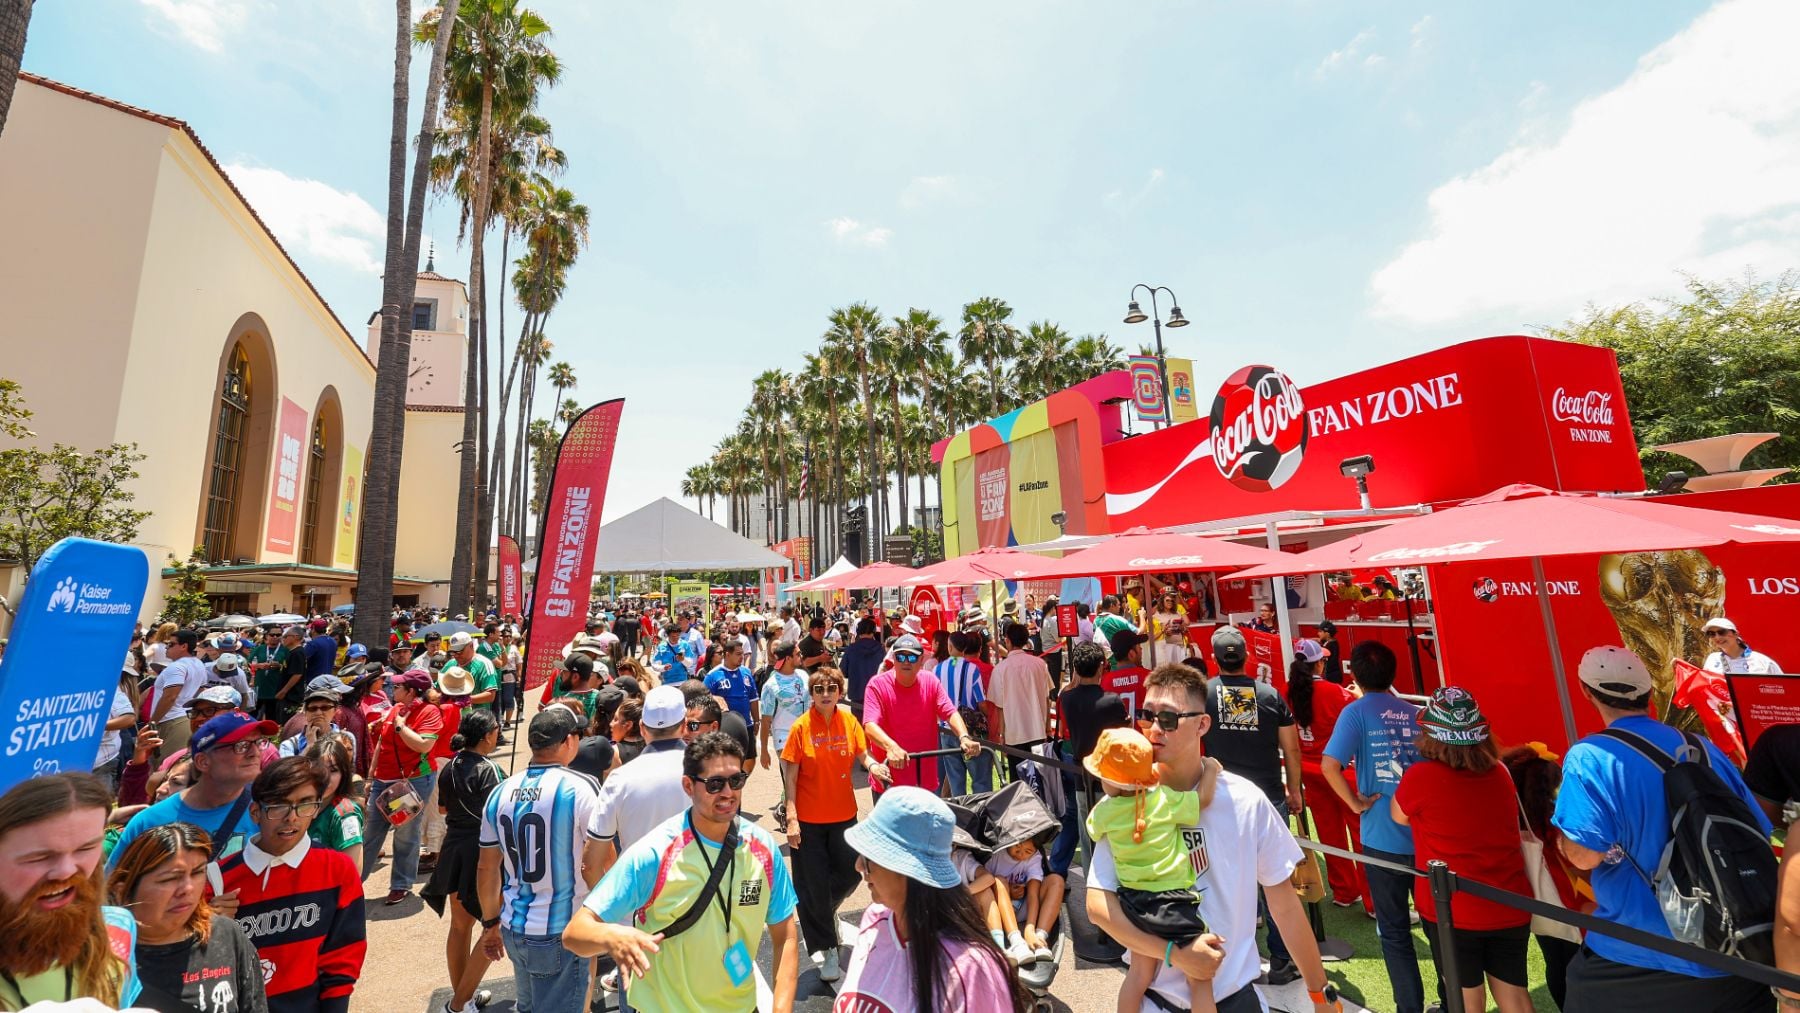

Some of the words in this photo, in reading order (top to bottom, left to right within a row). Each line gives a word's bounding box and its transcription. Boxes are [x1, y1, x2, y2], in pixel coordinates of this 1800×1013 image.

[1552, 387, 1614, 425] Coca-Cola
[1211, 368, 1304, 479] Coca-Cola
[1307, 397, 1364, 437] FAN
[1366, 372, 1463, 424] ZONE
[1569, 427, 1588, 442] FAN
[1588, 428, 1612, 443] ZONE
[986, 480, 1005, 498] FAN
[981, 496, 1004, 513] ZONE
[564, 486, 591, 546] ZONE
[559, 514, 569, 542] WORLD
[505, 564, 514, 585] ZONE
[553, 549, 577, 595] FAN
[80, 583, 112, 600] Kaiser
[506, 586, 514, 602] FAN
[1501, 581, 1532, 596] FAN
[1747, 577, 1800, 595] LOS
[74, 601, 131, 615] Permanente
[1113, 675, 1138, 687] RONALDO
[16, 689, 106, 723] SANITIZING
[1380, 709, 1410, 720] Alaska
[6, 712, 100, 756] STATION
[1436, 731, 1481, 742] MEXICO
[510, 787, 543, 802] MESSI
[500, 812, 546, 884] 10
[1182, 831, 1203, 850] SA
[739, 894, 760, 903] ZONE
[745, 885, 761, 895] FAN
[236, 907, 292, 938] EXICO
[294, 902, 318, 929] 70
[181, 971, 200, 984] Los
[201, 965, 231, 980] Angeles
